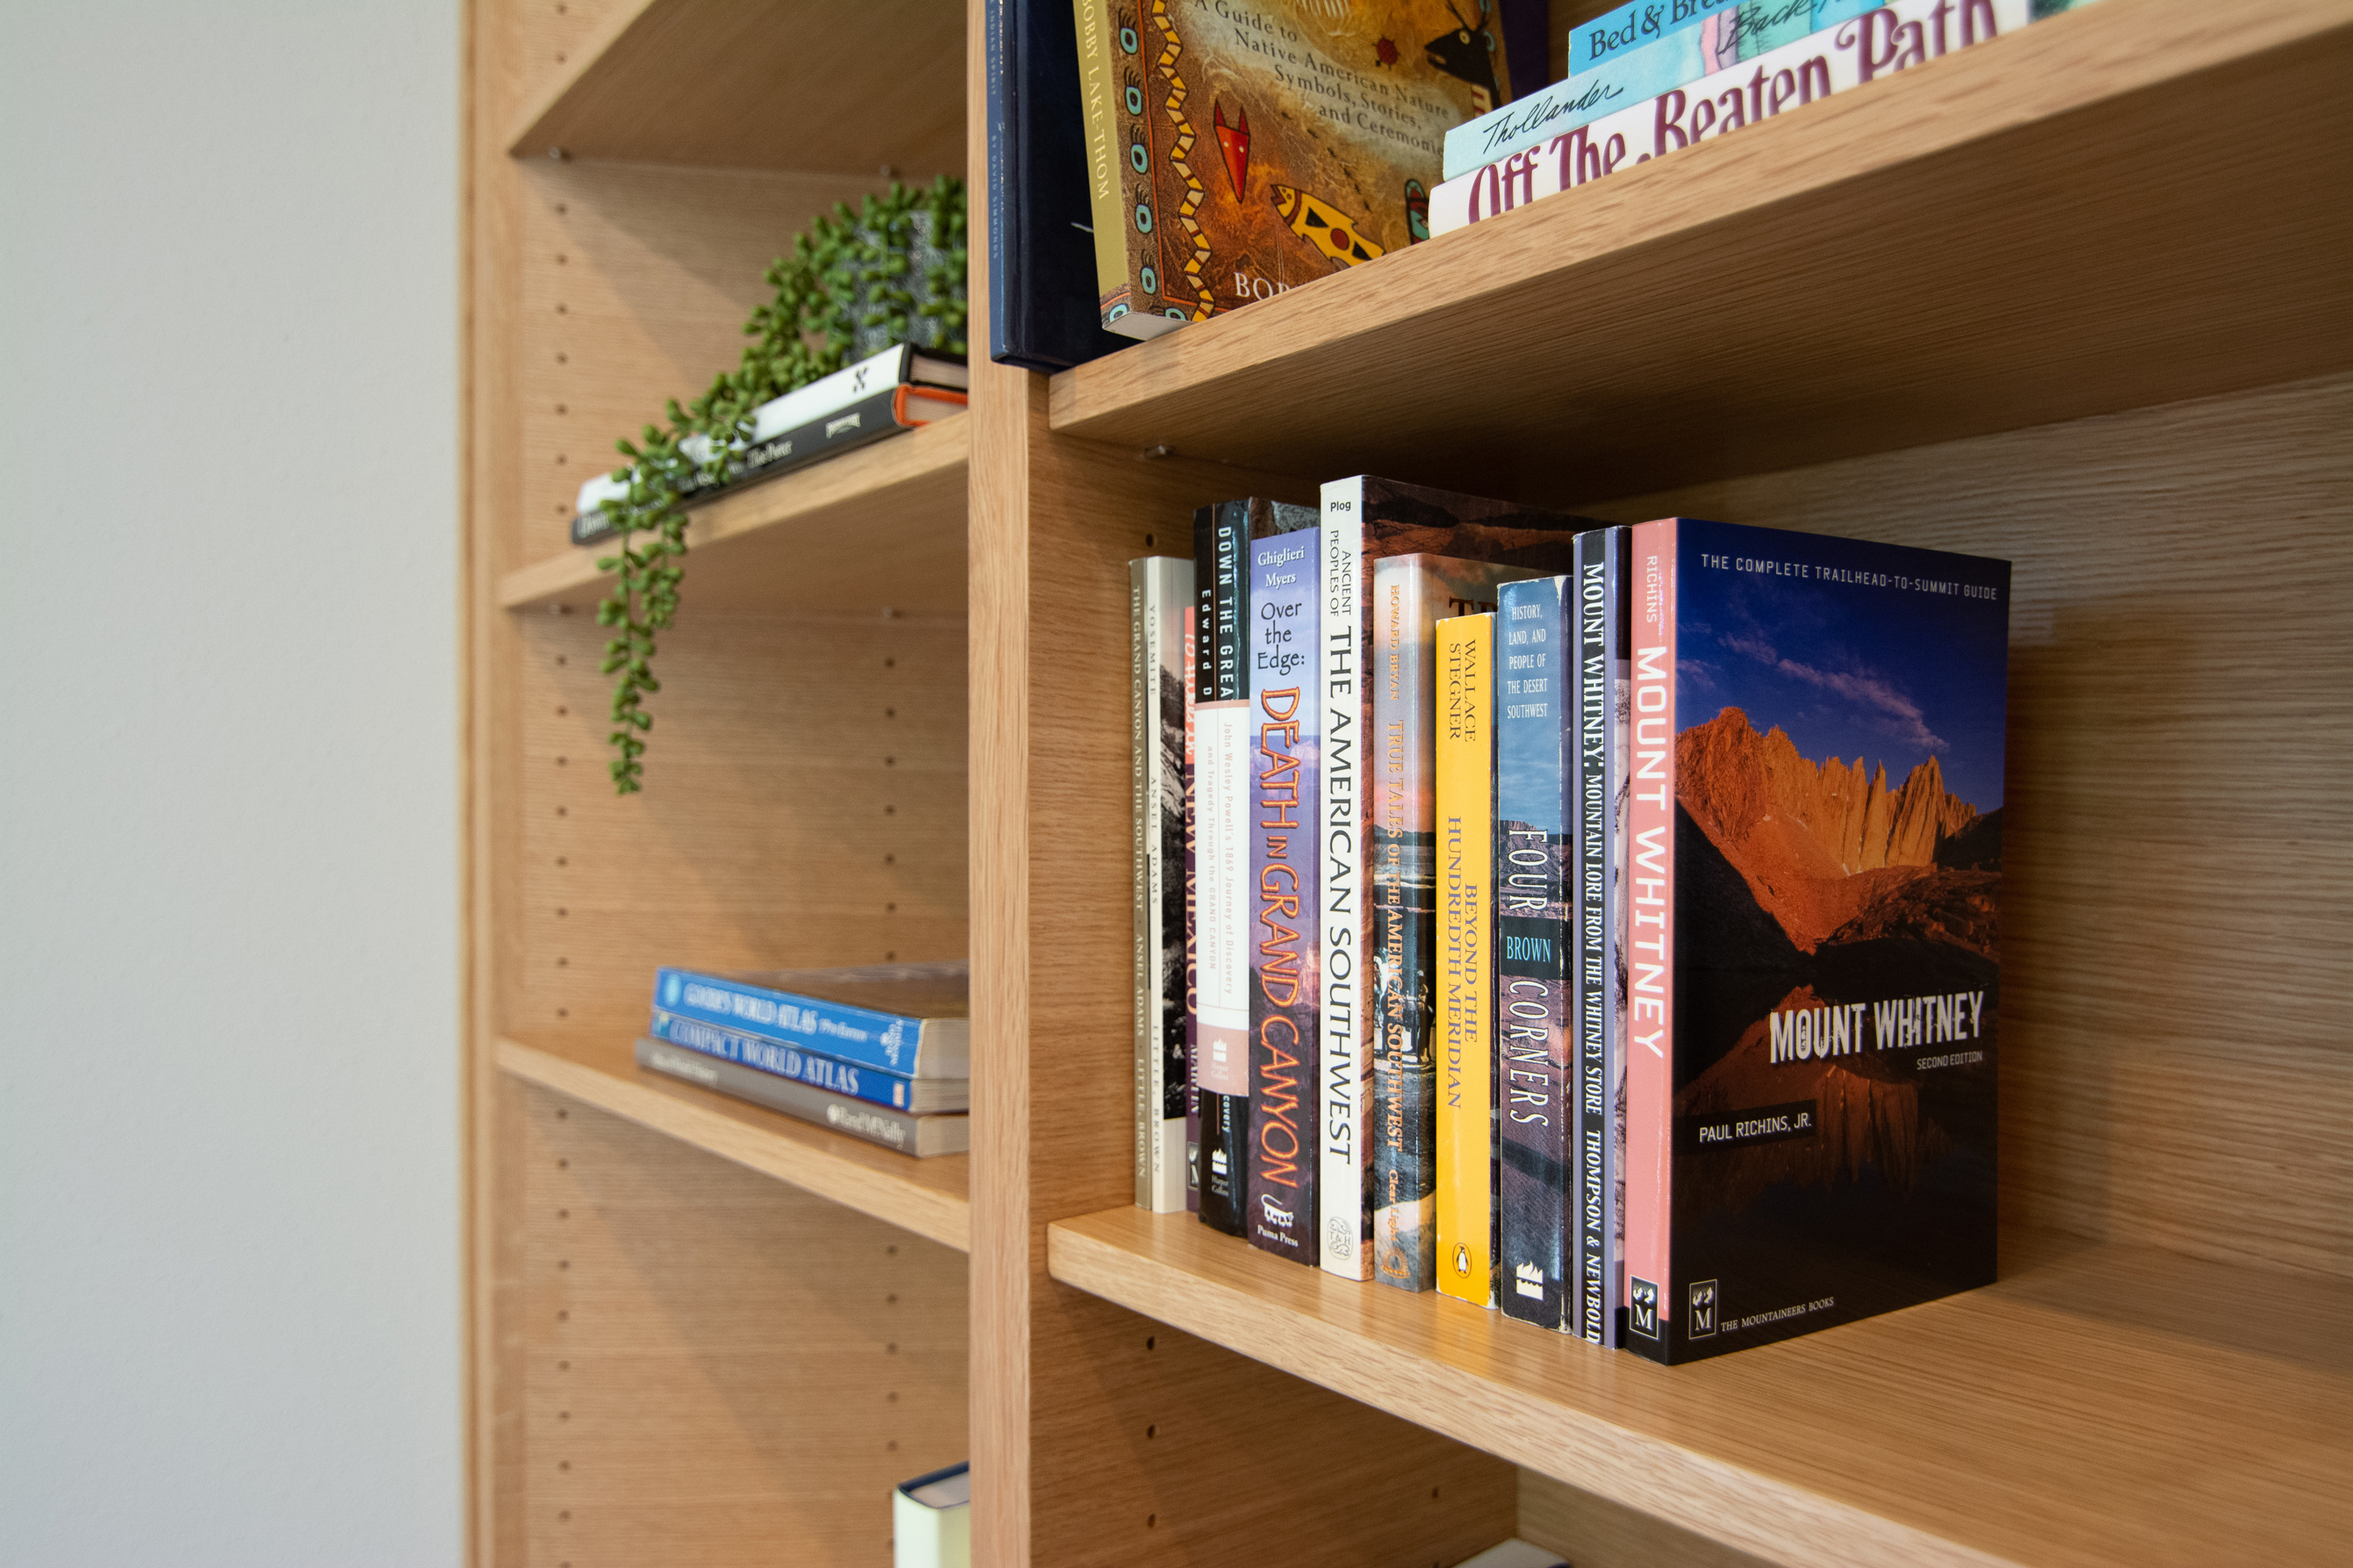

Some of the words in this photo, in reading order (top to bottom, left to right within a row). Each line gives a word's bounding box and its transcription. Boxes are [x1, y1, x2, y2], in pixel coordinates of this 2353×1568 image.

[1215, 0, 1273, 35] Guide
[1280, 26, 1298, 42] to
[1589, 11, 1637, 61] Bed
[1641, 5, 1665, 39] &
[1234, 28, 1297, 64] Native
[1305, 53, 1389, 96] American
[1395, 86, 1450, 119] Nature
[1275, 64, 1356, 109] Symbols,
[1361, 95, 1422, 131] Stories,
[1087, 66, 1110, 200] LAKE-THOM
[1319, 104, 1351, 125] and
[1469, 145, 1540, 226] Off
[1549, 125, 1626, 191] The
[1637, 55, 1831, 164] Beaten
[1834, 0, 1997, 85] Path
[1483, 79, 1623, 155] Thollander
[1330, 500, 1351, 512] Plog
[1219, 527, 1232, 585] DOWN
[1257, 546, 1305, 567] Ghiglieri
[1265, 572, 1297, 589] Myers
[1330, 530, 1340, 593] PEOPLES
[1701, 554, 1729, 570] THE
[1736, 557, 1809, 578] COMPLETE
[1815, 566, 1960, 595] TRAILHEAD-TO-SUMMIT
[1963, 585, 1997, 601] GUIDE
[1133, 585, 1141, 617] THE
[1329, 598, 1339, 617] OF
[1342, 550, 1351, 615] ANCIENT
[1583, 561, 1605, 647] MOUNT
[1646, 555, 1658, 624] RICHINS
[1201, 589, 1212, 670] Edward
[1220, 596, 1233, 635] THE
[1261, 601, 1302, 620] Over
[1265, 620, 1292, 644] the
[1390, 584, 1400, 651] HOWARD
[1511, 604, 1543, 620] HISTORY,
[1133, 621, 1142, 674] GRAND
[1257, 644, 1305, 676] Edge:
[1330, 625, 1352, 699] THE
[1508, 630, 1529, 646] LAND,
[1531, 629, 1546, 643] AND
[1508, 654, 1535, 670] PEOPLE
[1536, 653, 1546, 667] OF
[1390, 654, 1400, 701] BRYAN
[1449, 643, 1461, 740] STEGNER
[1464, 639, 1476, 742] WALLACE
[1507, 680, 1521, 694] THE
[1523, 679, 1548, 693] DESERT
[1133, 679, 1142, 740] CANYON
[1224, 723, 1233, 748] John
[1507, 703, 1548, 719] SOUTHWEST
[1583, 653, 1605, 767] WHITNEY:
[1636, 646, 1667, 810] MOUNT
[1223, 752, 1234, 792] Wesley
[1260, 686, 1301, 829] DEATH
[1388, 719, 1404, 774] TRUE
[1134, 782, 1143, 814] THE
[1205, 770, 1215, 813] Tragedy
[1329, 708, 1352, 915] AMERICAN
[1387, 778, 1404, 839] TALES
[1585, 773, 1602, 859] MOUNTAIN
[1135, 818, 1144, 911] SOUTHWEST
[1206, 817, 1215, 861] Through
[1225, 847, 1234, 872] 1869
[1267, 835, 1288, 859] IN
[1387, 843, 1400, 867] OF
[1387, 870, 1400, 905] THE
[1508, 829, 1549, 910] FOUR
[1585, 860, 1602, 903] LORE
[1224, 877, 1234, 921] Journey
[1448, 816, 1461, 981] HUNDREDTH
[1225, 924, 1234, 935] of
[1260, 862, 1300, 1008] GRAND
[1464, 883, 1478, 985] BEYOND
[1506, 936, 1551, 963] BROWN
[1585, 906, 1602, 951] FROM
[1634, 825, 1666, 1059] WHITNEY
[1224, 940, 1234, 996] Discovery
[1387, 909, 1403, 1019] AMERICAN
[1585, 956, 1602, 987] THE
[1136, 985, 1145, 1037] ADAMS
[1464, 990, 1478, 1043] THE
[1585, 990, 1602, 1063] WHITNEY
[1769, 1003, 1867, 1064] MOUNT
[1873, 990, 1985, 1050] WHITNEY
[1329, 926, 1351, 1165] SOUTHWEST
[1448, 982, 1461, 1109] MERIDIAN
[1508, 980, 1550, 1127] CORNERS
[1917, 1055, 1948, 1070] SECOND
[1950, 1050, 1983, 1066] EDITION
[803, 1056, 860, 1097] ATLAS
[1260, 1014, 1300, 1189] CANYON
[1387, 1023, 1403, 1152] SOUTHWEST
[1585, 1065, 1602, 1116] STORE
[1699, 1124, 1732, 1143] PAUL
[1736, 1115, 1791, 1139] RICHINS,
[1794, 1112, 1812, 1129] JR.
[1389, 1169, 1399, 1205] Clear
[1586, 1130, 1602, 1232] THOMPSON
[1257, 1224, 1278, 1241] Puma
[1279, 1234, 1299, 1248] Press
[1586, 1235, 1600, 1248] &
[1586, 1253, 1601, 1345] NEWBOLD
[1635, 1303, 1652, 1330] M
[1695, 1307, 1711, 1331] M
[1721, 1320, 1738, 1332] THE
[1741, 1304, 1806, 1327] MOUNTAINEERS
[1809, 1297, 1834, 1312] BOOKS
